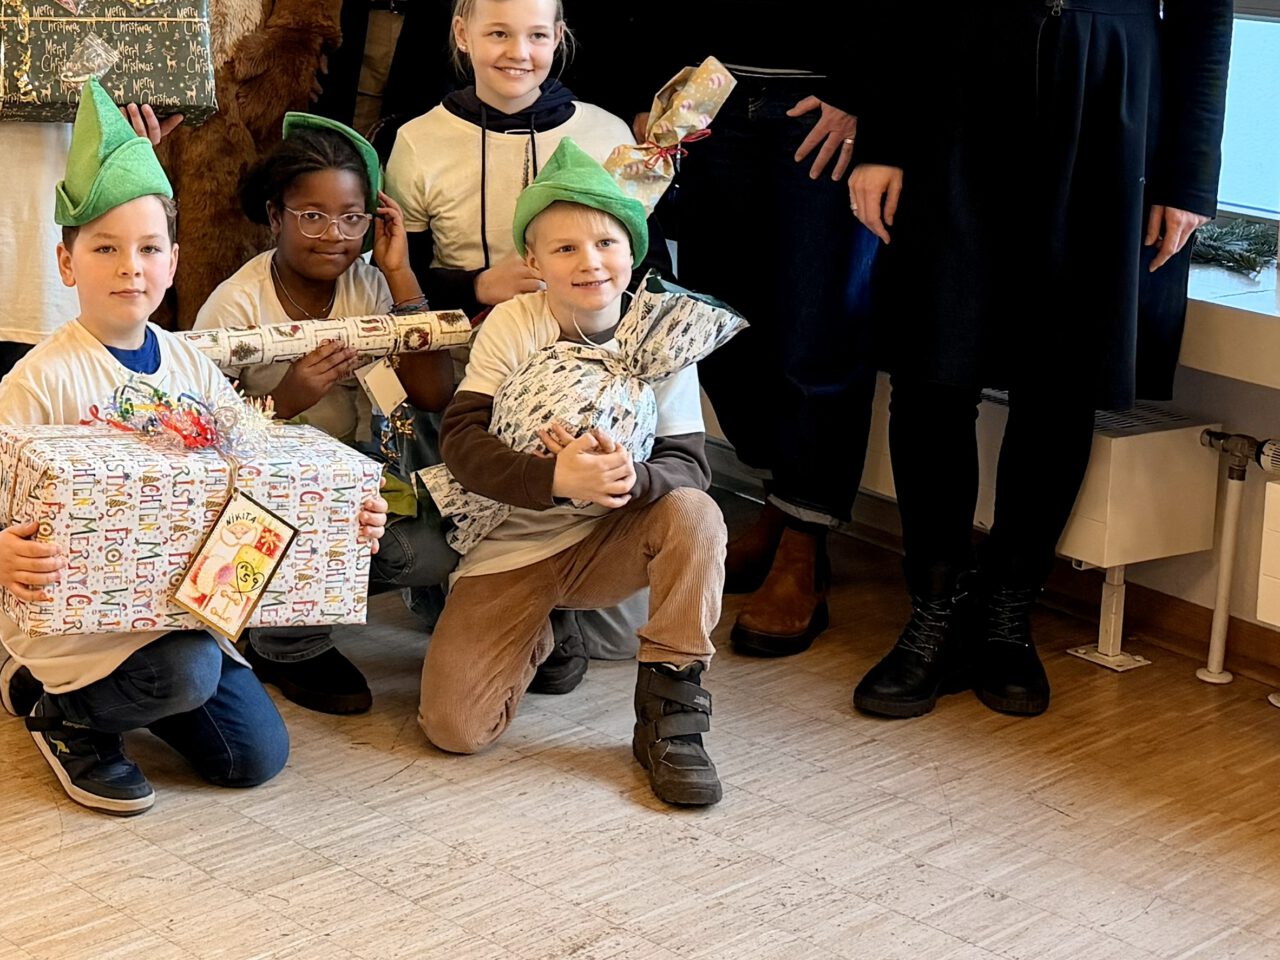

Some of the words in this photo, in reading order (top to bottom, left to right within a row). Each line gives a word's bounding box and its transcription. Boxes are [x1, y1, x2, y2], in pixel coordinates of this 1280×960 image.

[33, 4, 54, 17] Merry
[105, 5, 126, 17] Merry
[176, 6, 198, 22] Merry
[40, 20, 80, 34] Christmas
[112, 21, 152, 35] Christmas
[45, 39, 67, 56] Merry
[117, 40, 139, 58] Merry
[114, 58, 154, 74] Christmas
[133, 77, 155, 95] Merry
[140, 90, 180, 106] Christmas
[294, 490, 324, 591] CHRISTMAS
[324, 485, 356, 605] WEIHNACHTEN
[66, 512, 98, 590] MERRY
[103, 527, 132, 586] FROHE
[132, 537, 162, 611] MERRY
